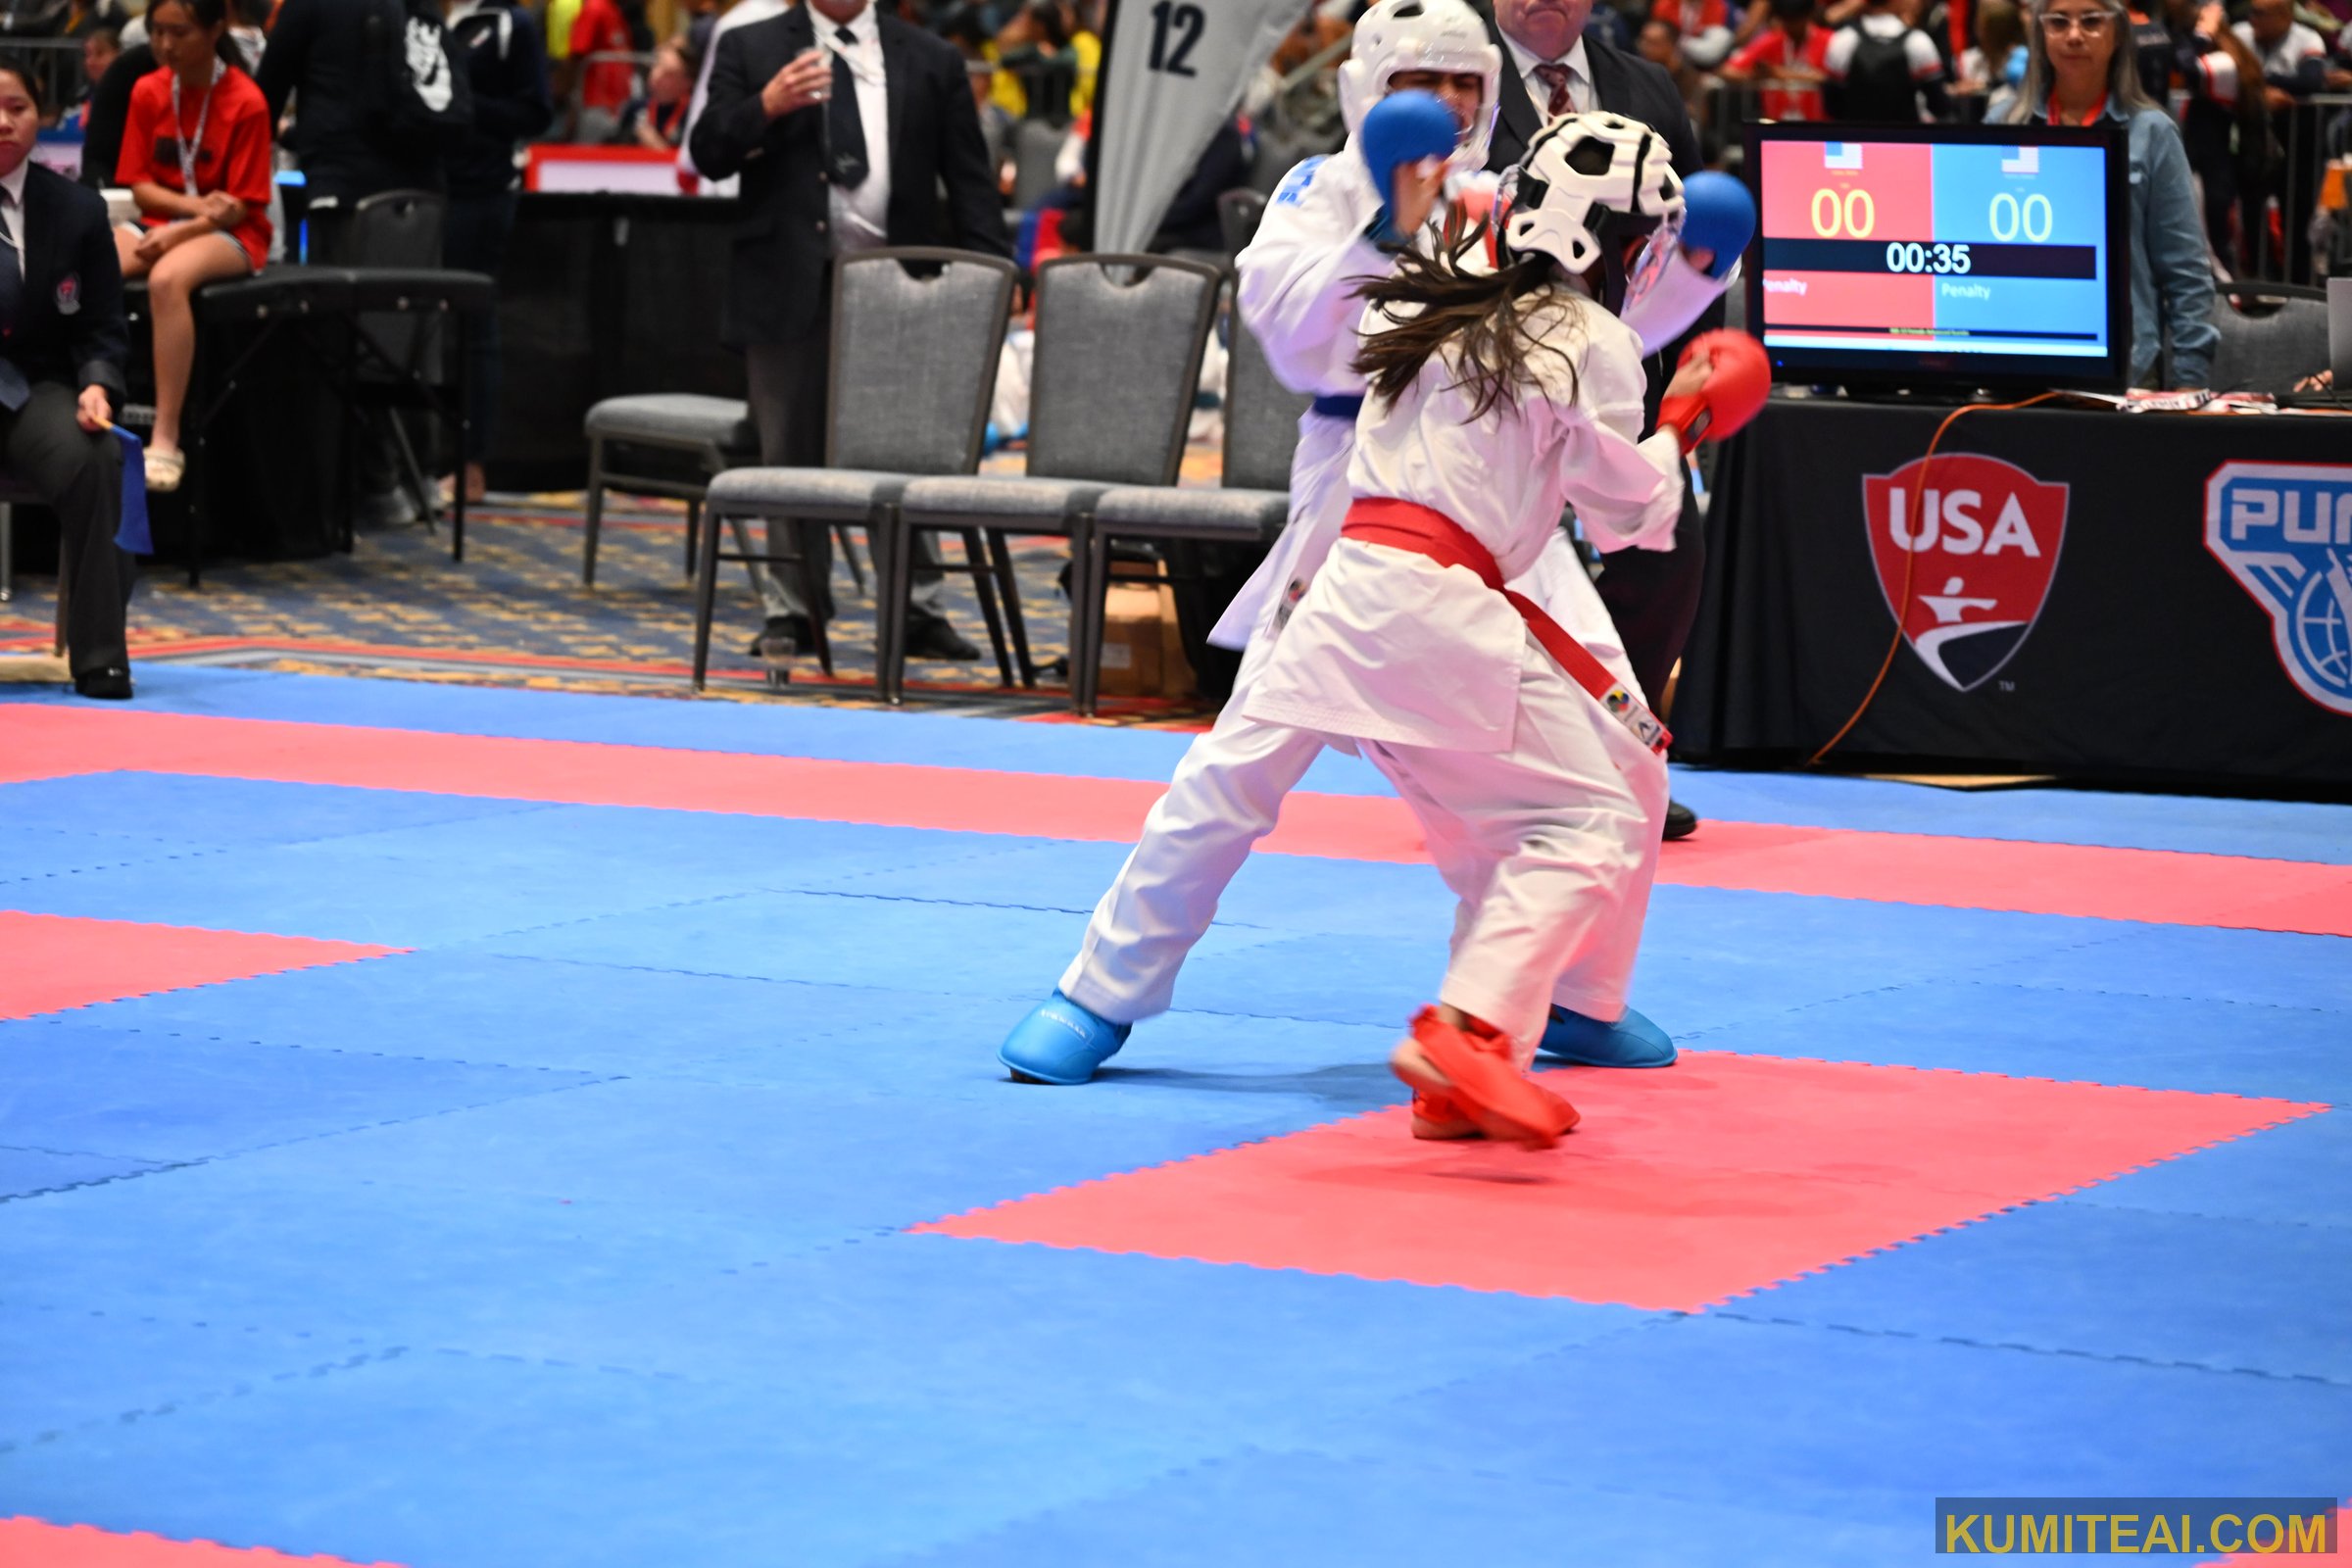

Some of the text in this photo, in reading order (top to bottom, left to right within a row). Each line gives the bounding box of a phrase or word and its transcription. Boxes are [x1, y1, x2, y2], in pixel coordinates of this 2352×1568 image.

[1149, 0, 1205, 76] 12
[1811, 188, 1875, 238] 00
[1988, 193, 2053, 242] 00
[1886, 242, 1971, 274] 00:35
[1941, 282, 1991, 300] Penalty
[1888, 487, 2041, 558] USA
